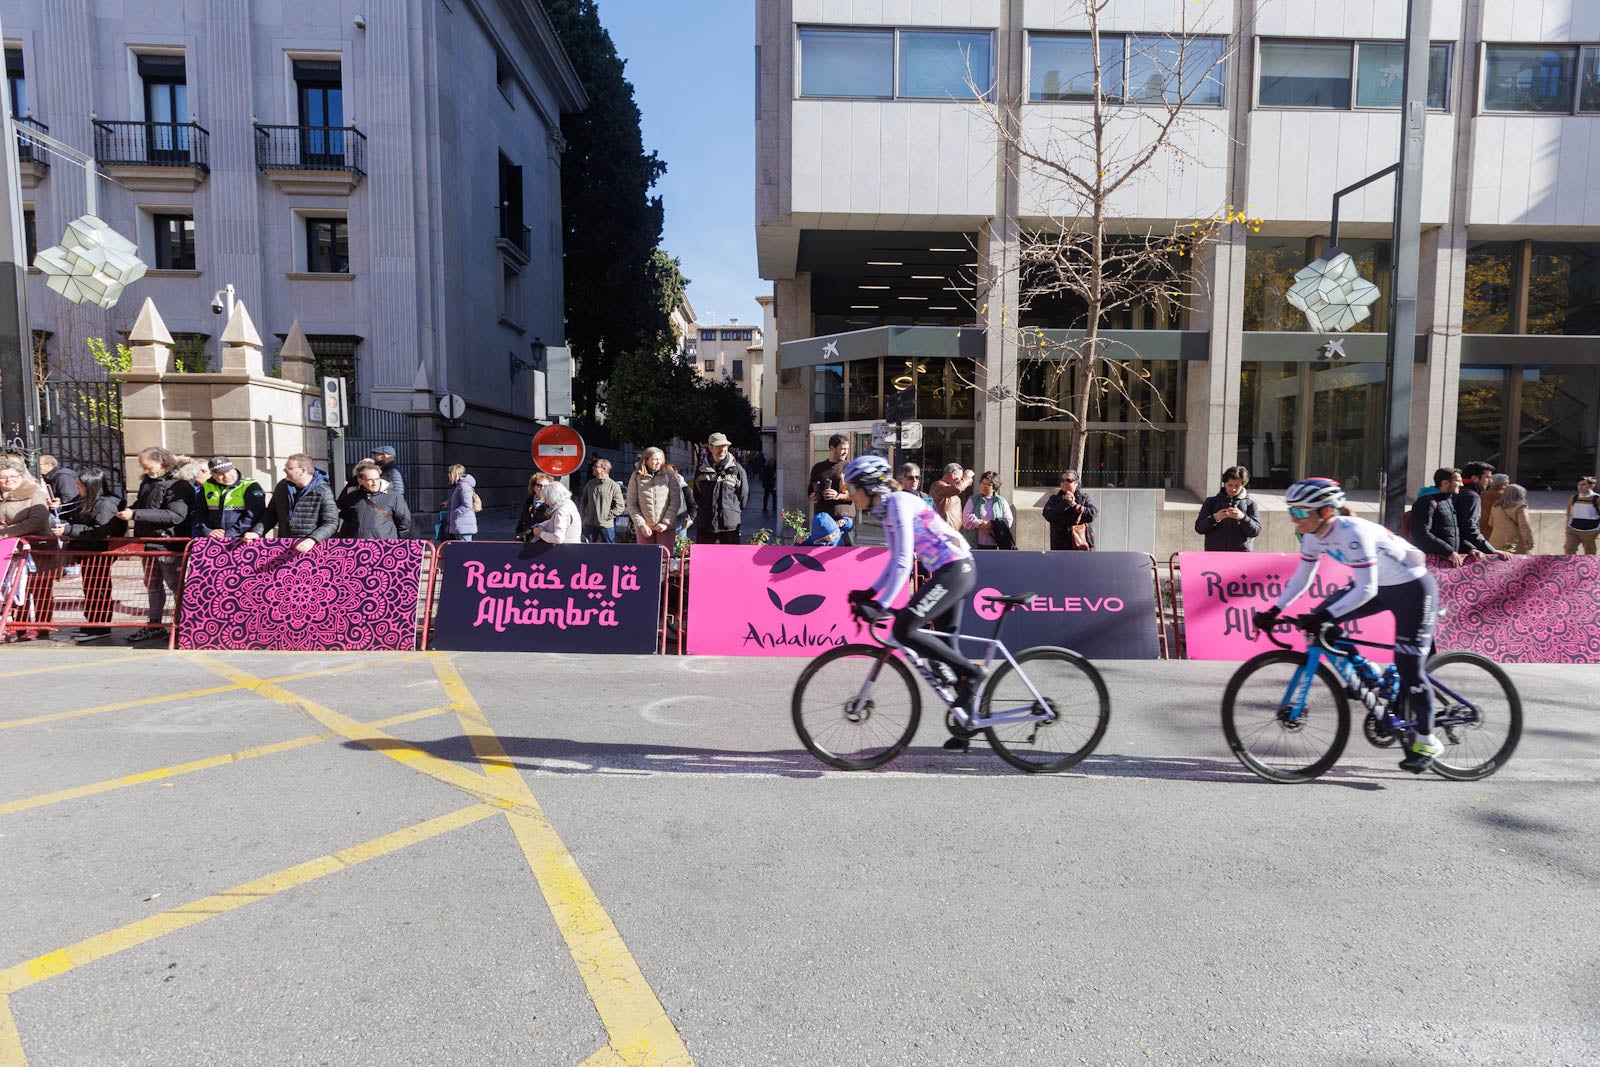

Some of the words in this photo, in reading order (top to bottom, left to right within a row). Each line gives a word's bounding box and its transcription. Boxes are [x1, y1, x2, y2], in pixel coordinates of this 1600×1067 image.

[570, 563, 607, 590] de
[1201, 571, 1289, 603] Reinä
[742, 622, 849, 649] Andalucía
